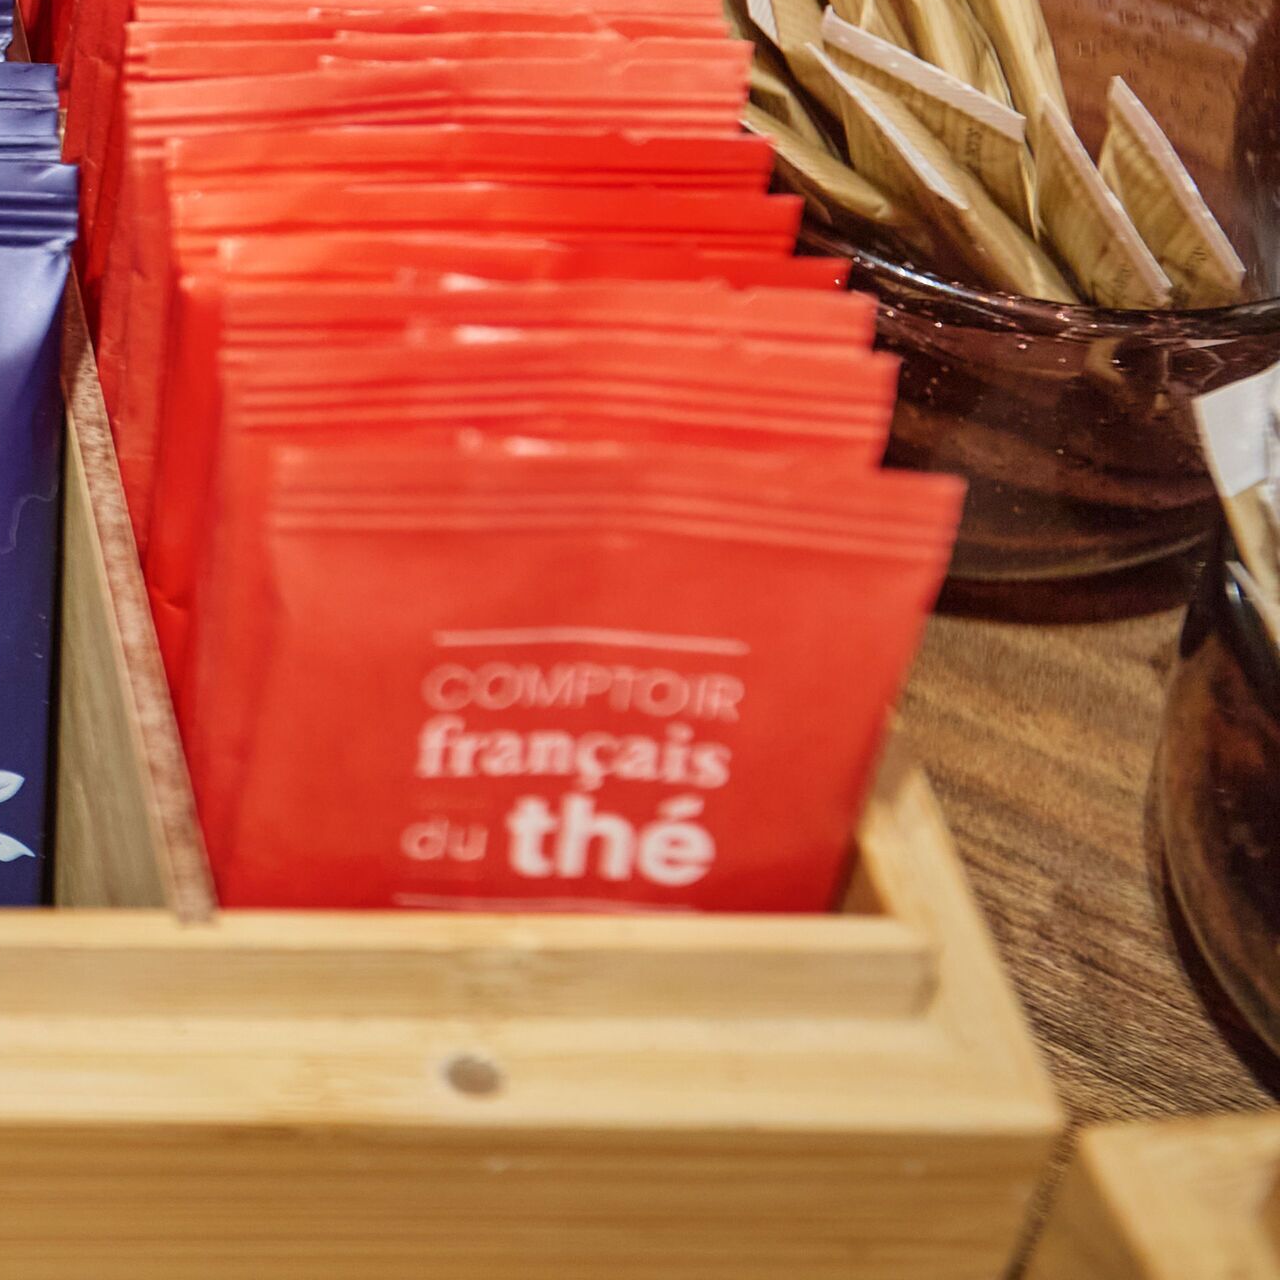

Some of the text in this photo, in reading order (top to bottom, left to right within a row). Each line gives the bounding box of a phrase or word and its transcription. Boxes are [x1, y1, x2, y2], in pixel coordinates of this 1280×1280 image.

[420, 663, 746, 722] COMPTOIR
[416, 716, 732, 791] français
[400, 793, 717, 887] du thé
